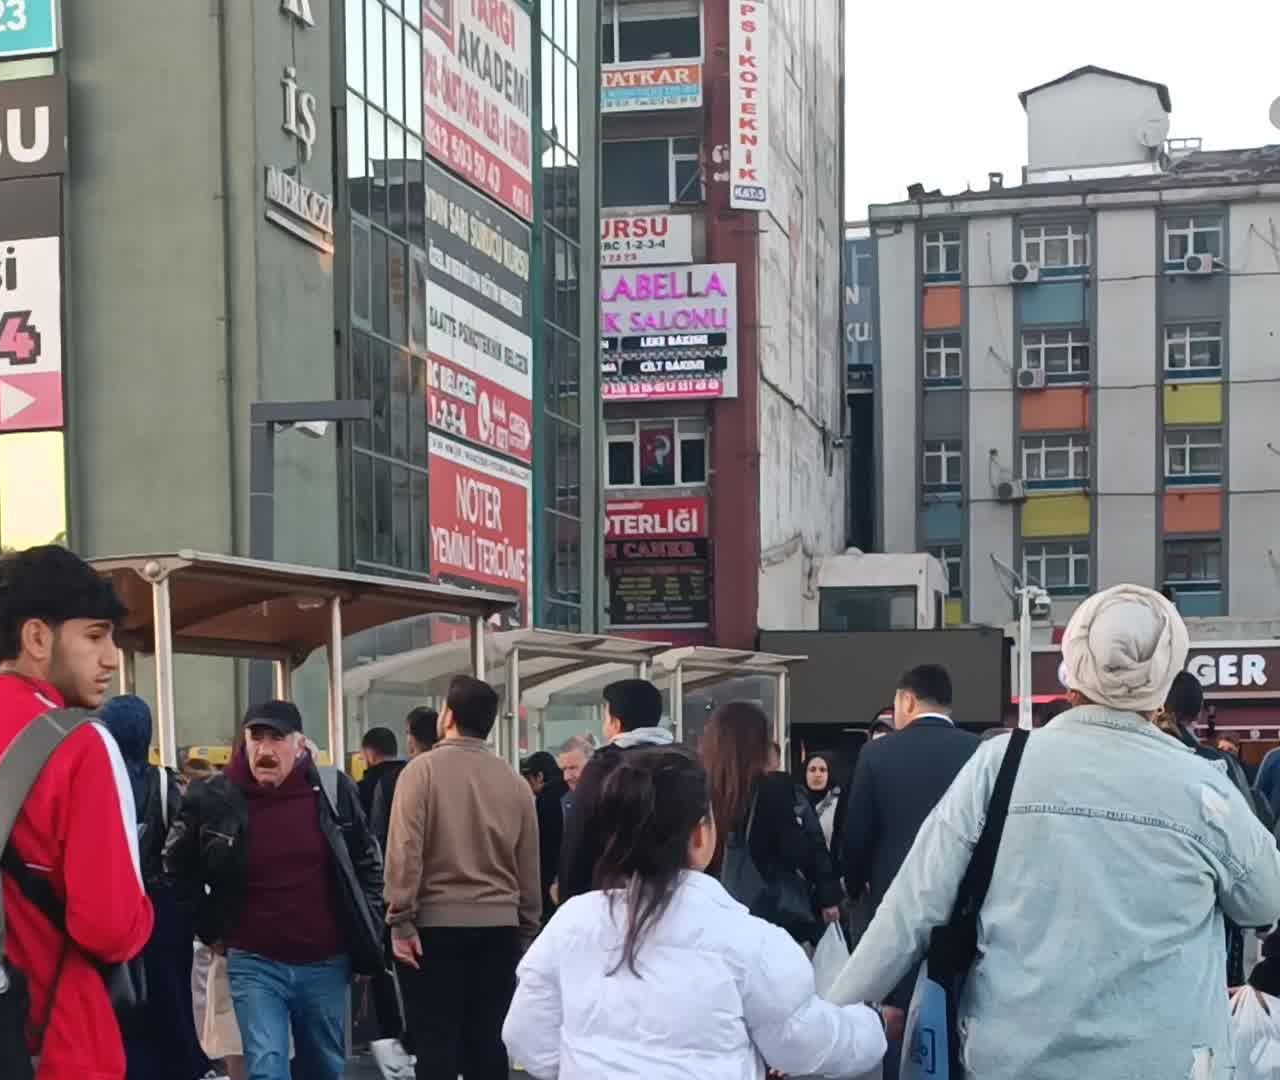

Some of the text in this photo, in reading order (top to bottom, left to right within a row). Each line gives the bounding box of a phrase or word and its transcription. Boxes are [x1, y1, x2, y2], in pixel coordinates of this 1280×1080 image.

[280, 66, 316, 162] İŞ
[601, 271, 728, 302] ABELLA
[629, 307, 728, 332] SALONU
[455, 472, 503, 533] NOTER
[431, 525, 476, 571] YEMİNLİ
[1187, 653, 1267, 687] GER
